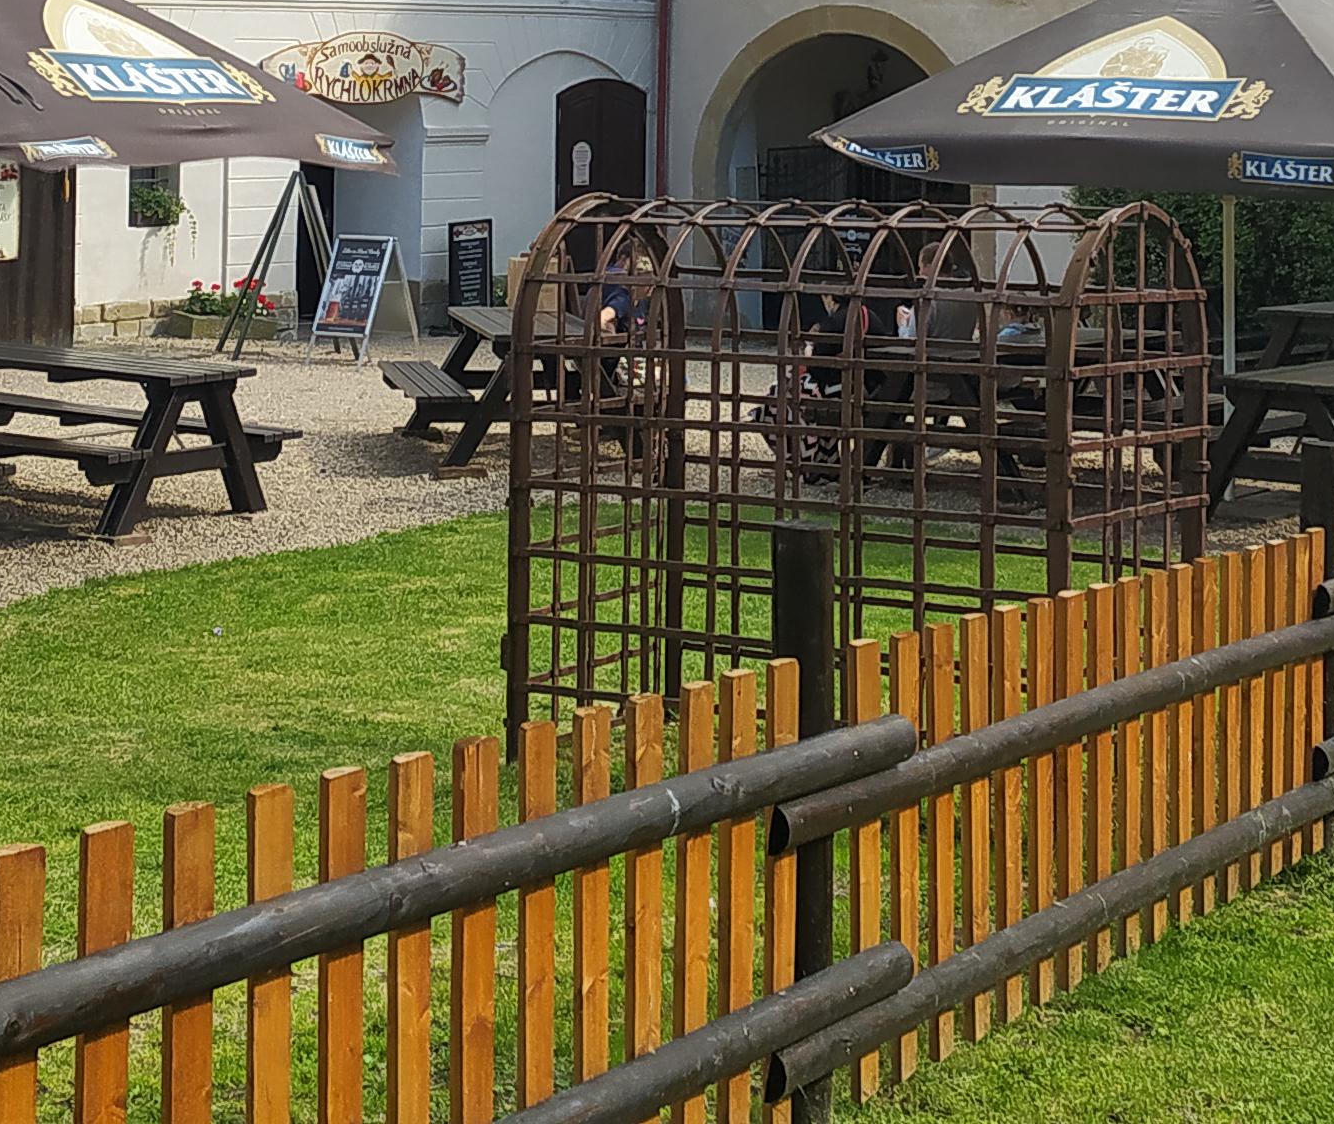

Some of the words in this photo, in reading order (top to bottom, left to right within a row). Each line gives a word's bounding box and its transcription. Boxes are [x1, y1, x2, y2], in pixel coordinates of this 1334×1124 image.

[67, 61, 247, 96] KLÁŠTER
[1001, 81, 1219, 114] KLÁŠTER
[1245, 159, 1334, 183] KLÁŠTER
